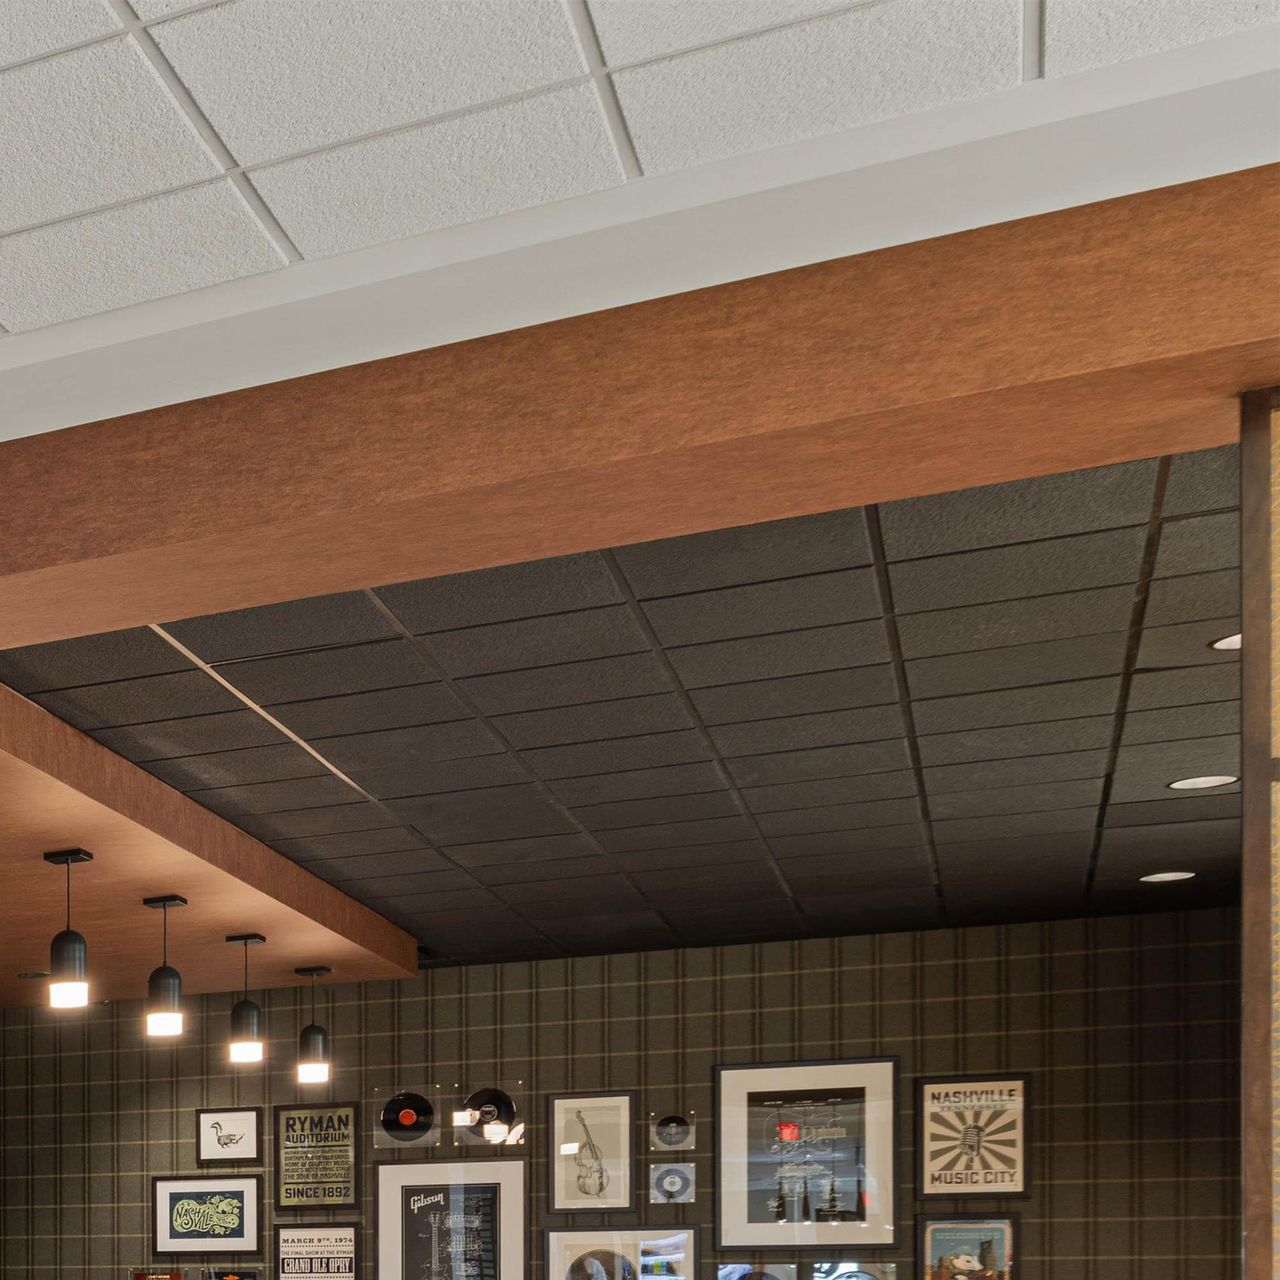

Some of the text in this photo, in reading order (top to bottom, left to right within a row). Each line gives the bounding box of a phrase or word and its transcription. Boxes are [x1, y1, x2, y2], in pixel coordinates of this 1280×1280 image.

[931, 1089, 1016, 1104] NASHVILLE
[285, 1114, 349, 1133] RYMAN
[285, 1132, 350, 1144] AUDITORIUM
[930, 1170, 1017, 1185] MUSIC CITY
[285, 1186, 350, 1199] SINCE 1892
[410, 1193, 445, 1214] Gibson
[175, 1207, 214, 1230] NASHVILLE
[284, 1257, 351, 1273] GRAND OLE OPRY
